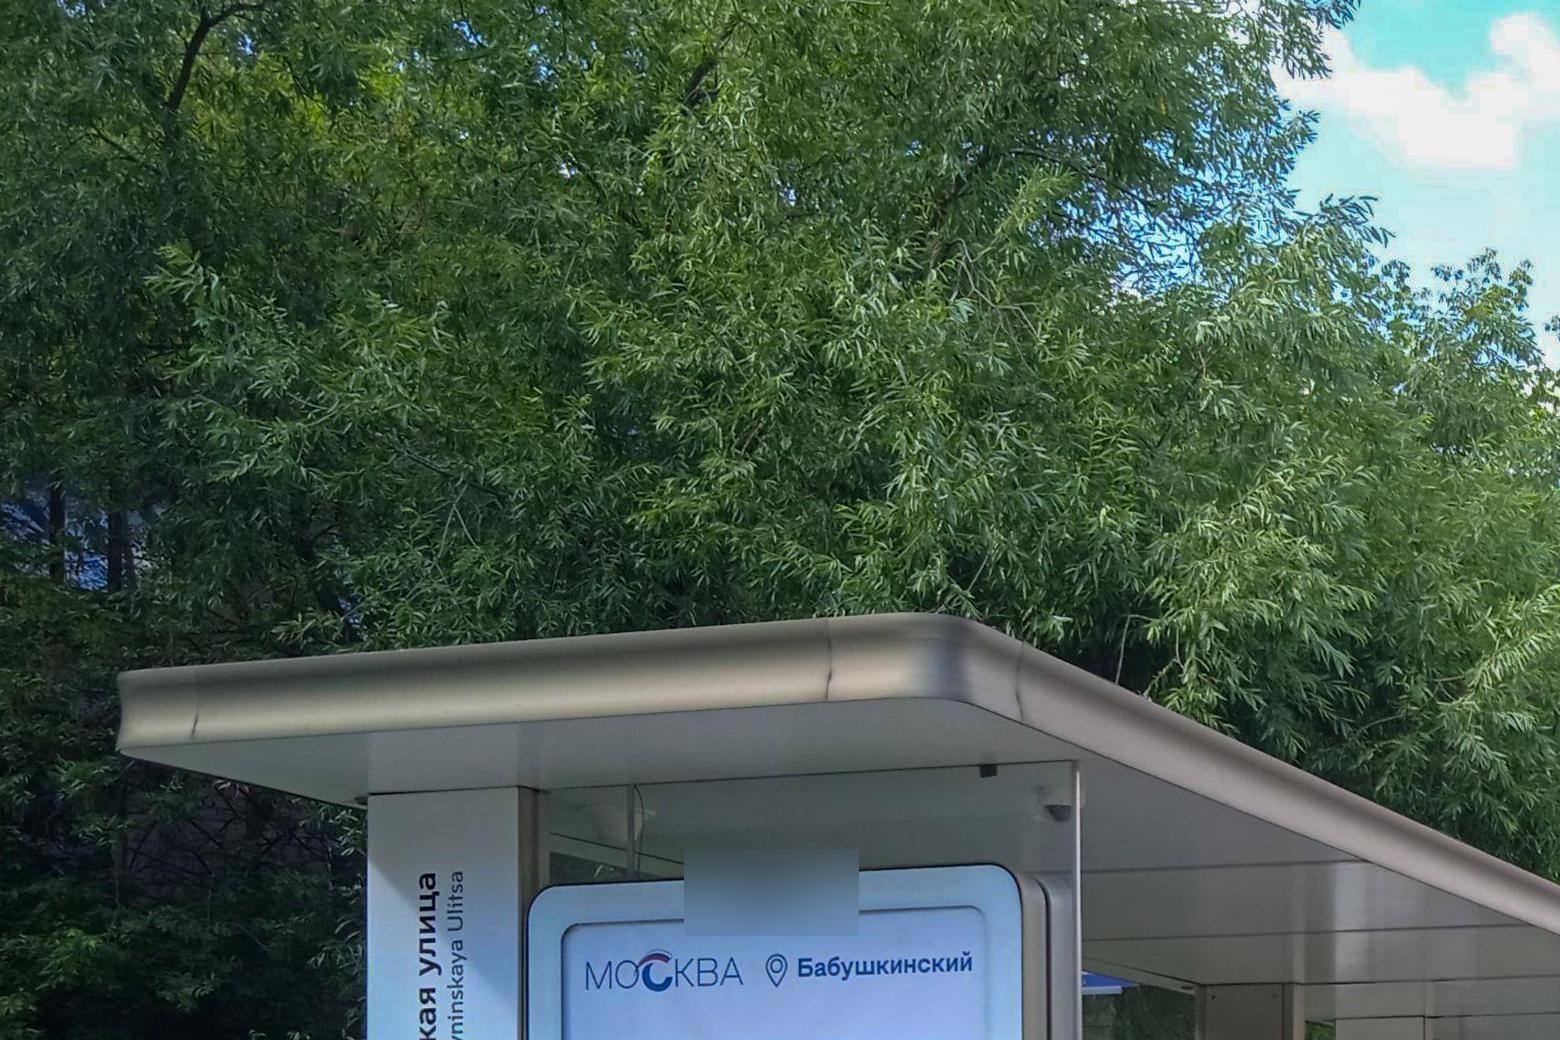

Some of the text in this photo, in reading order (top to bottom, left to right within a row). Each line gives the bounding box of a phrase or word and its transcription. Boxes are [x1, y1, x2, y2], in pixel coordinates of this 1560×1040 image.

[418, 872, 442, 977] улица
[446, 870, 464, 932] Ulitsa
[585, 949, 744, 992] МОСКВА
[798, 951, 973, 981] Бабушкинский
